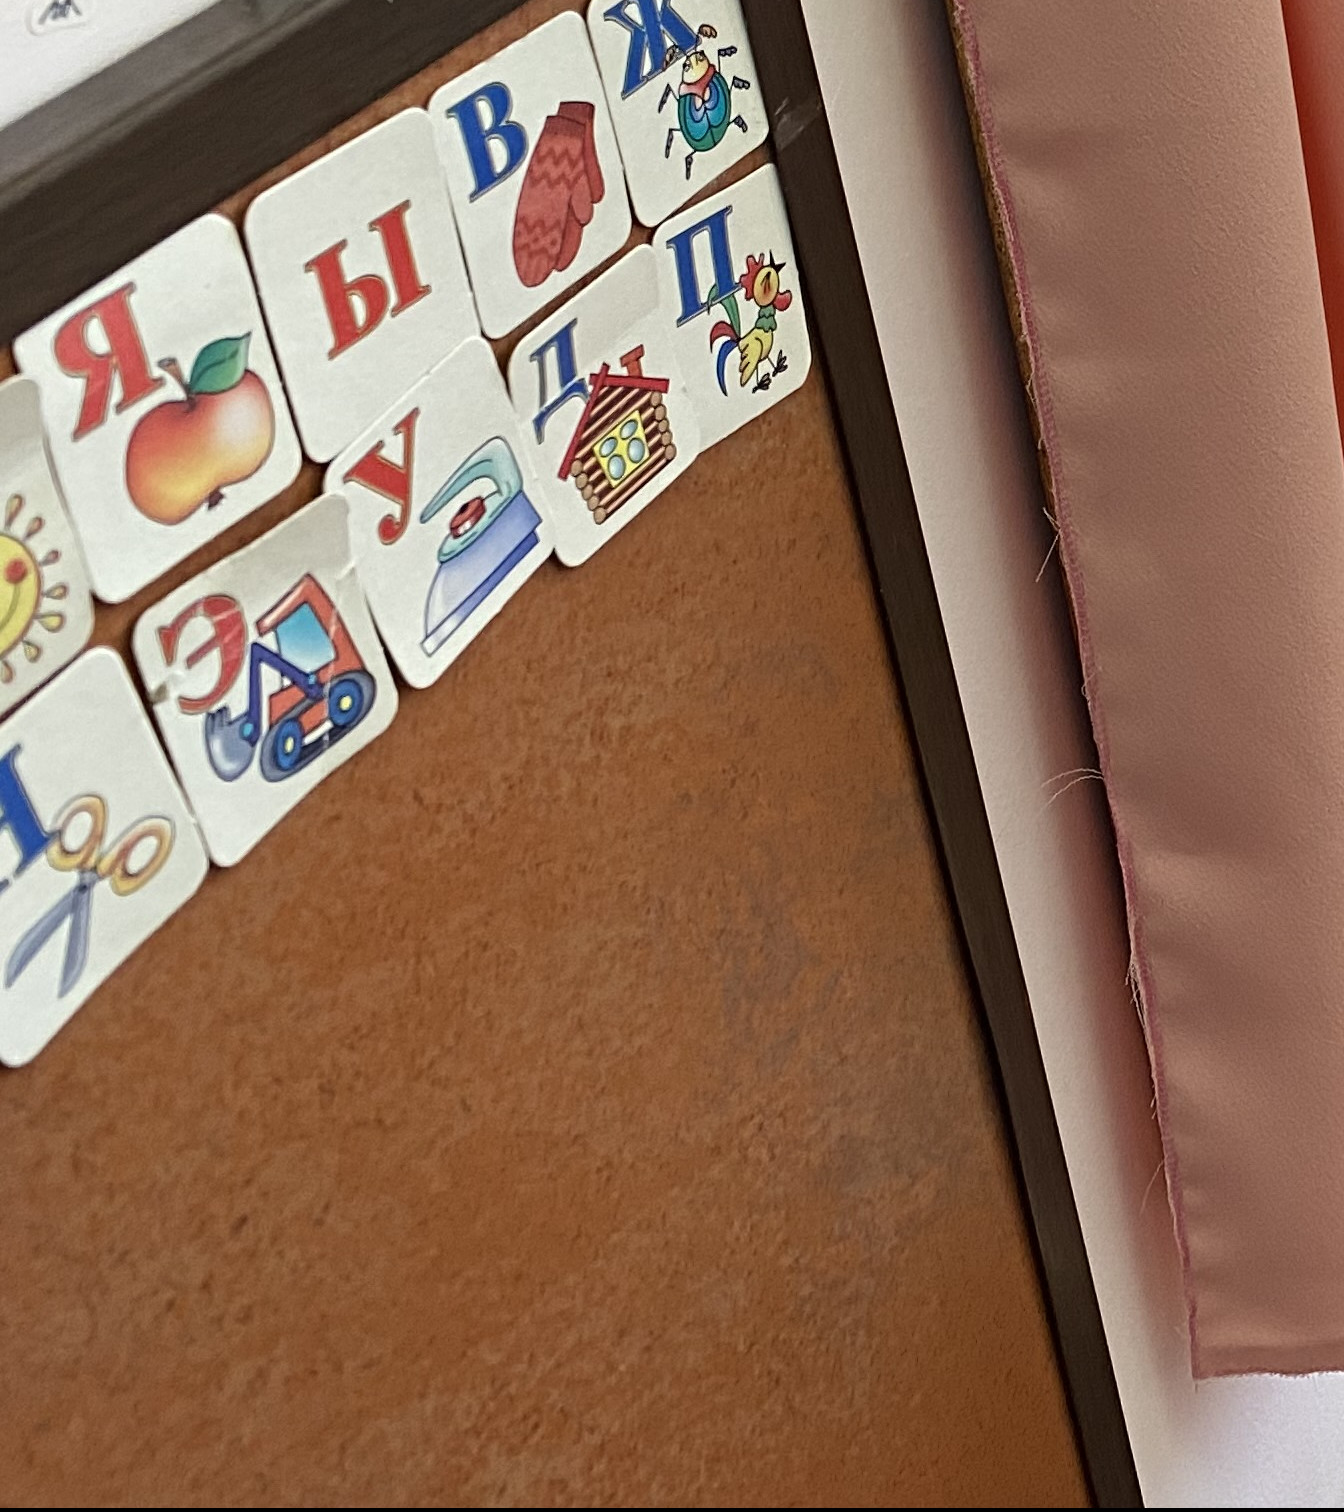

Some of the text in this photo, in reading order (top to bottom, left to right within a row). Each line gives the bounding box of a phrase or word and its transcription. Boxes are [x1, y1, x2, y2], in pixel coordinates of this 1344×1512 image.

[446, 80, 528, 203] В
[304, 199, 432, 361] Ы
[666, 204, 742, 328] П
[53, 281, 166, 442] Я
[529, 317, 592, 445] Д
[343, 406, 420, 546] У
[157, 593, 248, 715] Э
